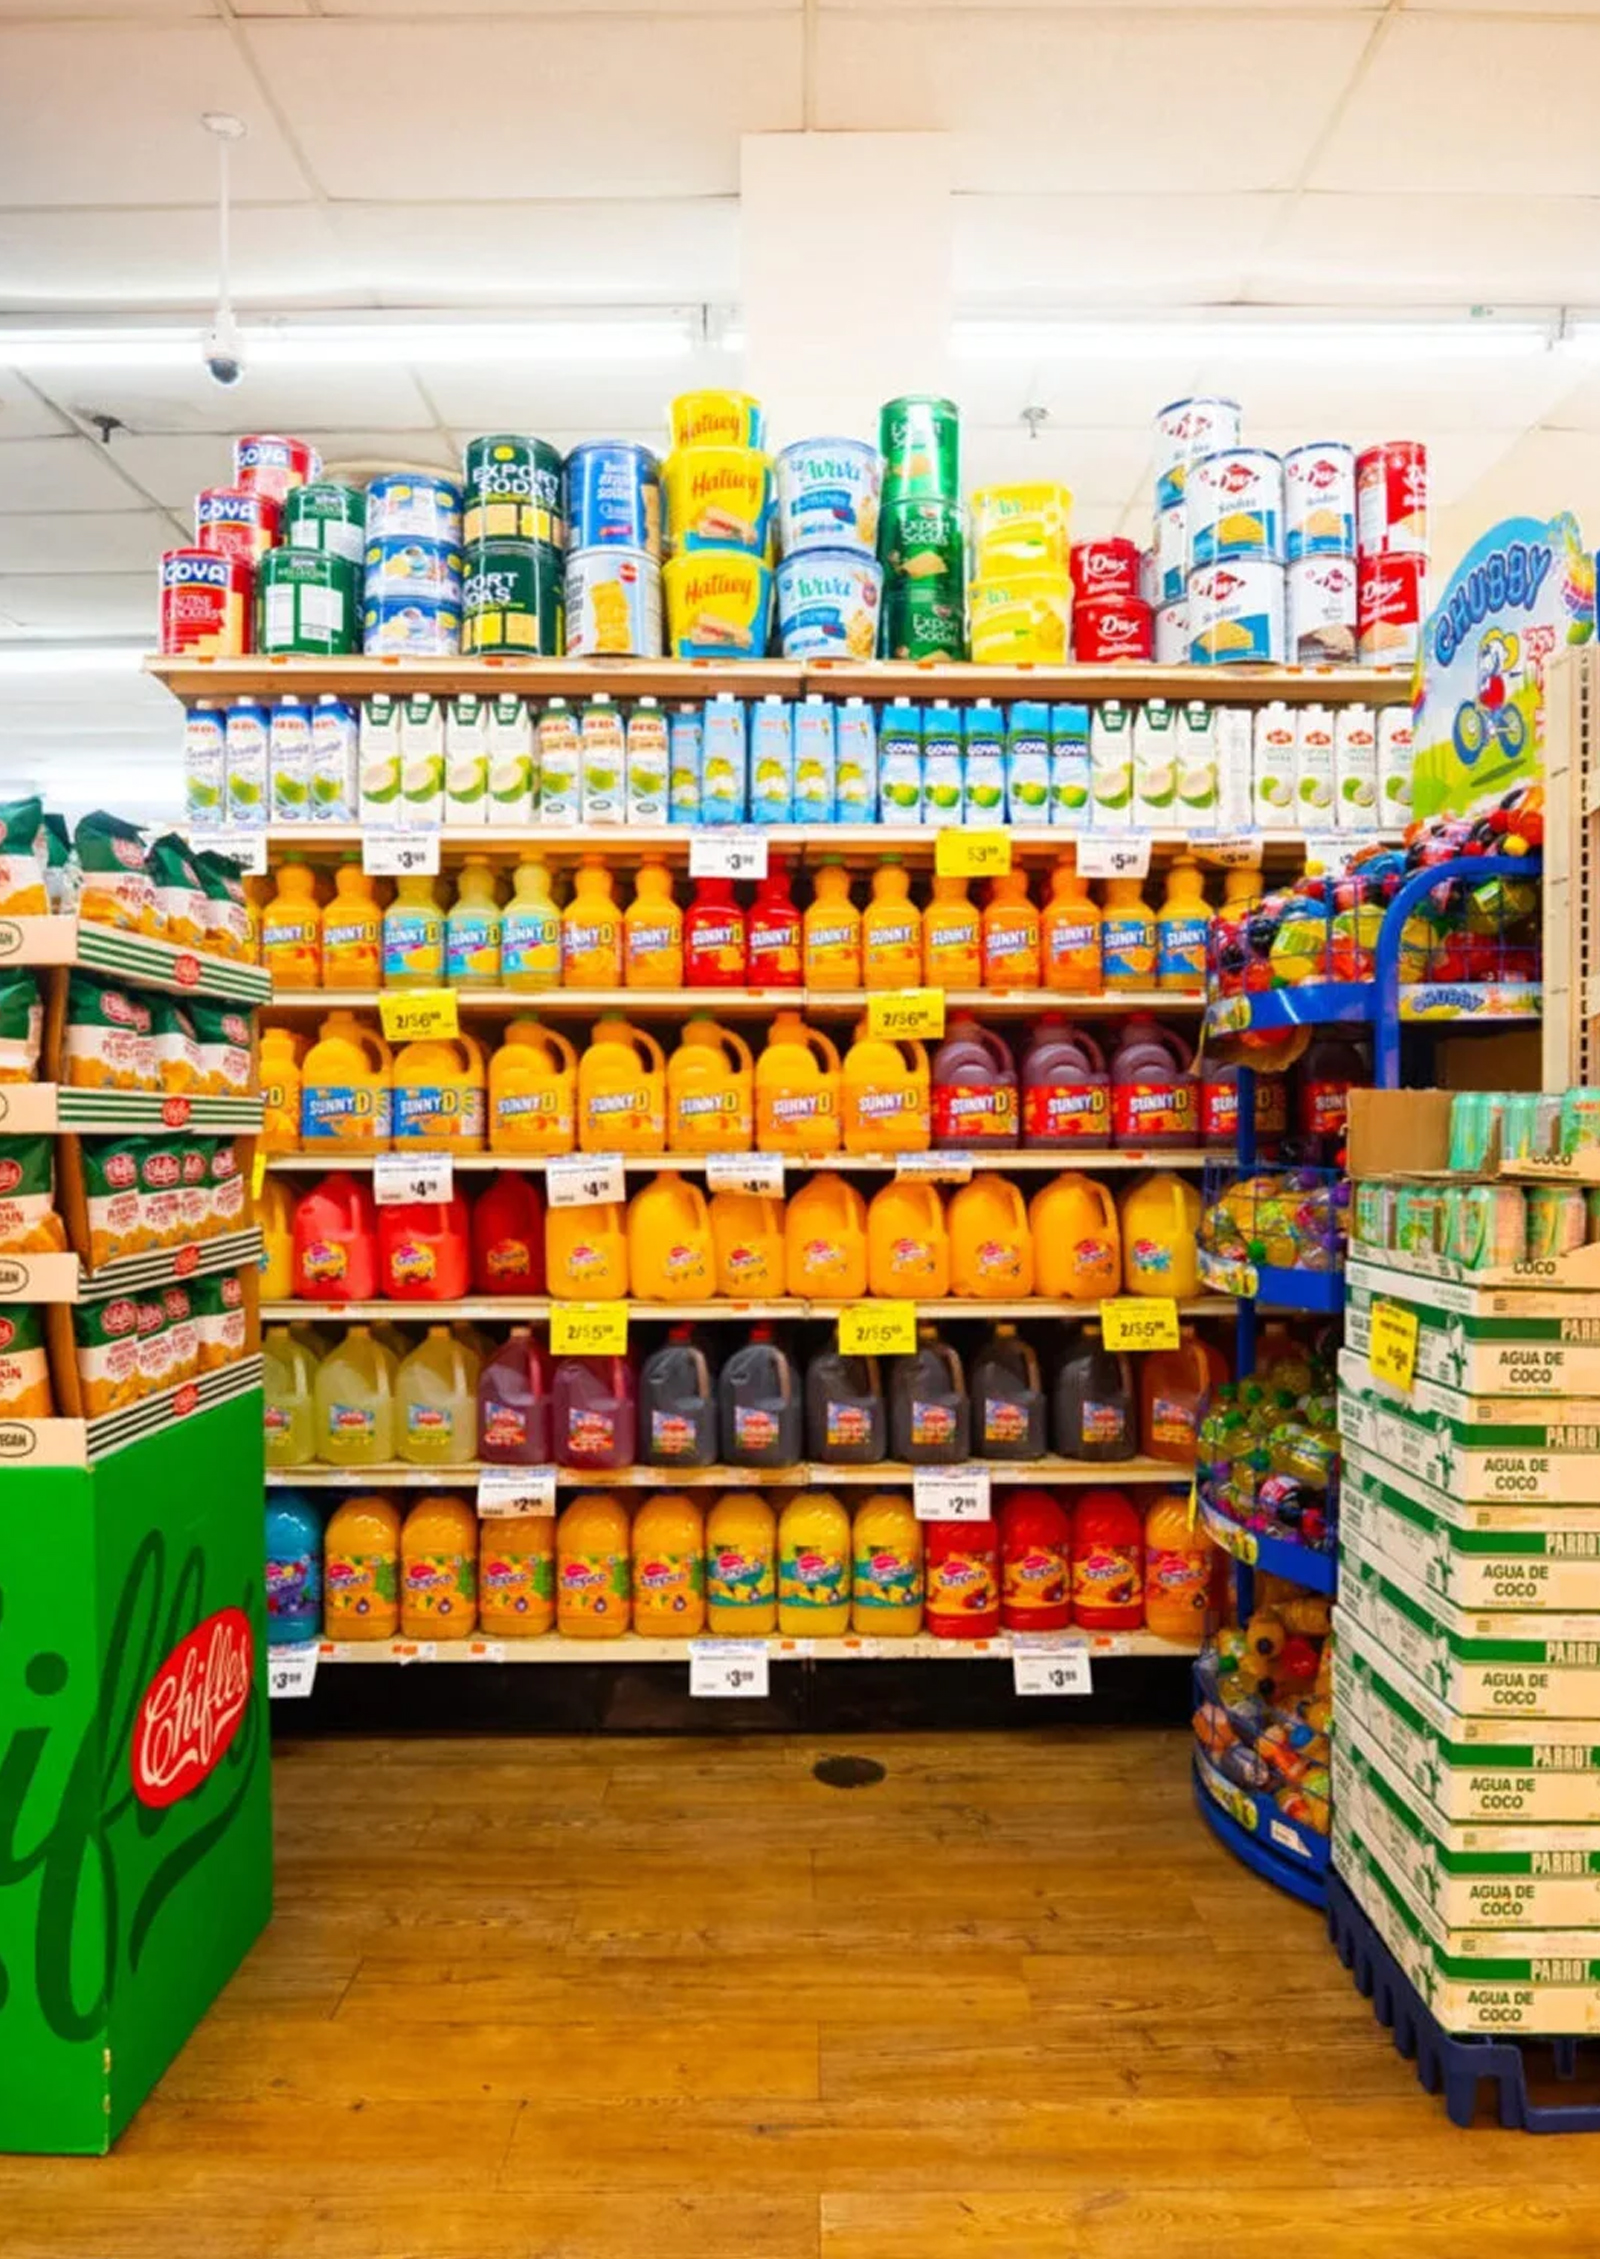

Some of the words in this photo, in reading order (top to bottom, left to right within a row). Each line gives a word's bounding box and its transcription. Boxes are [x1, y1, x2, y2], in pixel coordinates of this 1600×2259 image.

[473, 463, 559, 491] EXPORT
[479, 478, 557, 506] SODAS
[199, 504, 257, 520] GOYA
[1090, 553, 1127, 571] Dux
[165, 561, 227, 583] GOYA
[1434, 542, 1551, 667] CHUBBY
[1101, 614, 1139, 632] Dux
[1513, 1261, 1556, 1275] COCO
[1499, 1351, 1540, 1365] AGUA
[1545, 1352, 1564, 1366] DE
[1510, 1369, 1552, 1383] COCO
[1546, 1426, 1600, 1447] PARRO
[1484, 1458, 1526, 1472] AGUA
[1529, 1458, 1548, 1472] DE
[1495, 1476, 1537, 1490] COCO
[1483, 1565, 1525, 1579] AGUA
[1529, 1566, 1548, 1579] DE
[1494, 1583, 1537, 1597] COCO
[1482, 1672, 1524, 1687] AGUA
[1528, 1673, 1548, 1688] DE
[140, 1623, 248, 1787] Chifles
[1493, 1690, 1536, 1705] COCO
[1470, 1777, 1511, 1792] AGUA
[1516, 1778, 1536, 1792] DE
[1480, 1795, 1523, 1809] COCO
[1470, 1885, 1511, 1899] AGUA
[1515, 1885, 1535, 1899] DE
[1481, 1902, 1523, 1915] COCO
[1468, 1990, 1511, 2005] AGUA
[1514, 1991, 1534, 2005] DE
[1479, 2008, 1522, 2022] COCO
